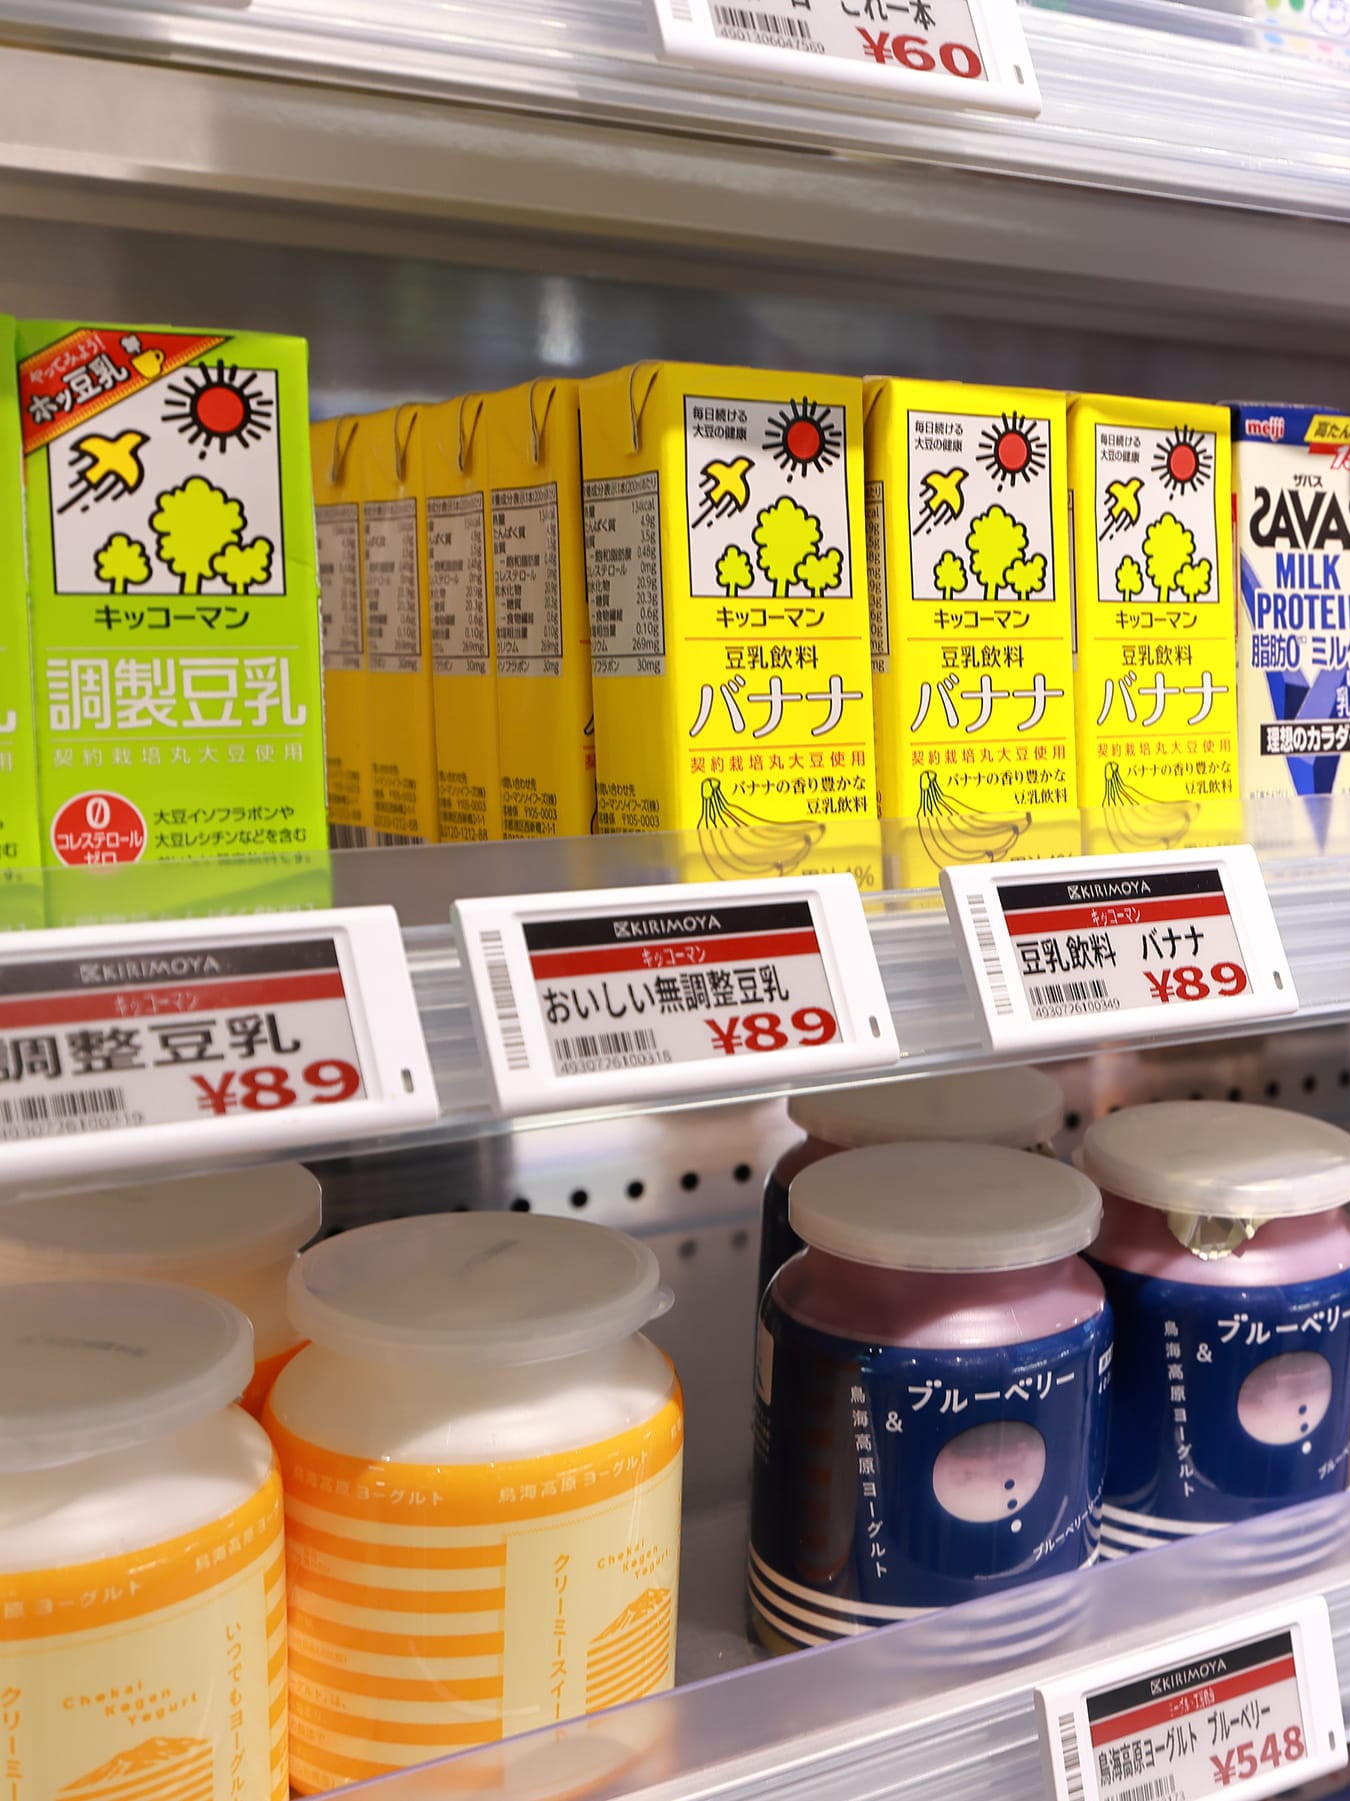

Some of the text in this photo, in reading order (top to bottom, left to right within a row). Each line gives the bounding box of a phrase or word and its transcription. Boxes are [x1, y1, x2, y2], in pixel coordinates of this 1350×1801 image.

[855, 26, 982, 79] ¥60
[27, 352, 130, 425] ホッ豆乳
[692, 405, 749, 423] 毎日続ける
[692, 425, 748, 441] 大豆の健康
[914, 420, 964, 436] 毎日続ける
[1245, 416, 1286, 442] meiji
[914, 437, 963, 453] 大豆の健康
[1100, 433, 1142, 447] 毎日続ける
[1100, 449, 1141, 464] 大豆の健康
[1293, 473, 1324, 489] ザバス
[1275, 552, 1341, 590] MILK
[94, 606, 250, 632] キッコーマン
[716, 607, 825, 629] キッコーマン
[934, 609, 1030, 630] キッコーマン
[1115, 610, 1198, 630] キッコーマン
[725, 644, 819, 671] 豆乳飲料
[941, 645, 1025, 669] 豆乳飲料
[1122, 644, 1193, 667] 豆乳飲料
[46, 654, 307, 732] 調製豆乳
[910, 673, 1065, 734] バナナ
[1097, 670, 1230, 727] バナナ
[689, 674, 864, 740] バナナ
[53, 743, 303, 769] 契約栽培丸大豆使用
[911, 745, 1067, 768] 契約栽培丸大豆使用
[1097, 739, 1232, 759] 契約栽培丸大豆使用
[690, 751, 867, 775] 契約栽培丸大豆使用
[1127, 761, 1232, 778] バナナの香り豊かな
[732, 776, 867, 797] バナナの香り豊かな
[946, 767, 1067, 788] バナナの香り豊かな
[1185, 779, 1233, 796] 豆乳飲料
[806, 796, 868, 816] 豆乳飲料
[1014, 788, 1068, 806] 豆乳飲料
[154, 805, 295, 825] 大豆イソフラボンや
[57, 832, 144, 851] コレステロール
[155, 828, 307, 849] 大豆レシチンなどを含む
[1082, 879, 1152, 900] KIRIMOYA
[630, 914, 722, 937] KIRIMOYA
[1091, 906, 1142, 928] キッコーマン
[642, 945, 707, 968] キッコーマン
[1016, 925, 1205, 977] 豆乳飲料 バナナ
[102, 955, 221, 983] KIRIMOYA
[542, 963, 790, 1025] おいしい無調整豆乳
[1143, 961, 1248, 1004] ¥89
[114, 991, 200, 1016] キッコーマン
[704, 1006, 838, 1056] ¥89
[190, 1058, 361, 1117] ¥89
[1196, 1343, 1213, 1363] &
[908, 1371, 1075, 1415] ブルーベリー
[1164, 1320, 1195, 1498] 鳥海高原ヨーグルト
[885, 1411, 903, 1433] &
[850, 1385, 888, 1579] 鳥海高原ヨーグルト
[1162, 1657, 1227, 1692] KIRIMOYA
[1098, 1721, 1198, 1788] 鳥海高原ヨーグルト
[1207, 1699, 1271, 1746] ブルーベリー
[1210, 1725, 1306, 1787] ¥548
